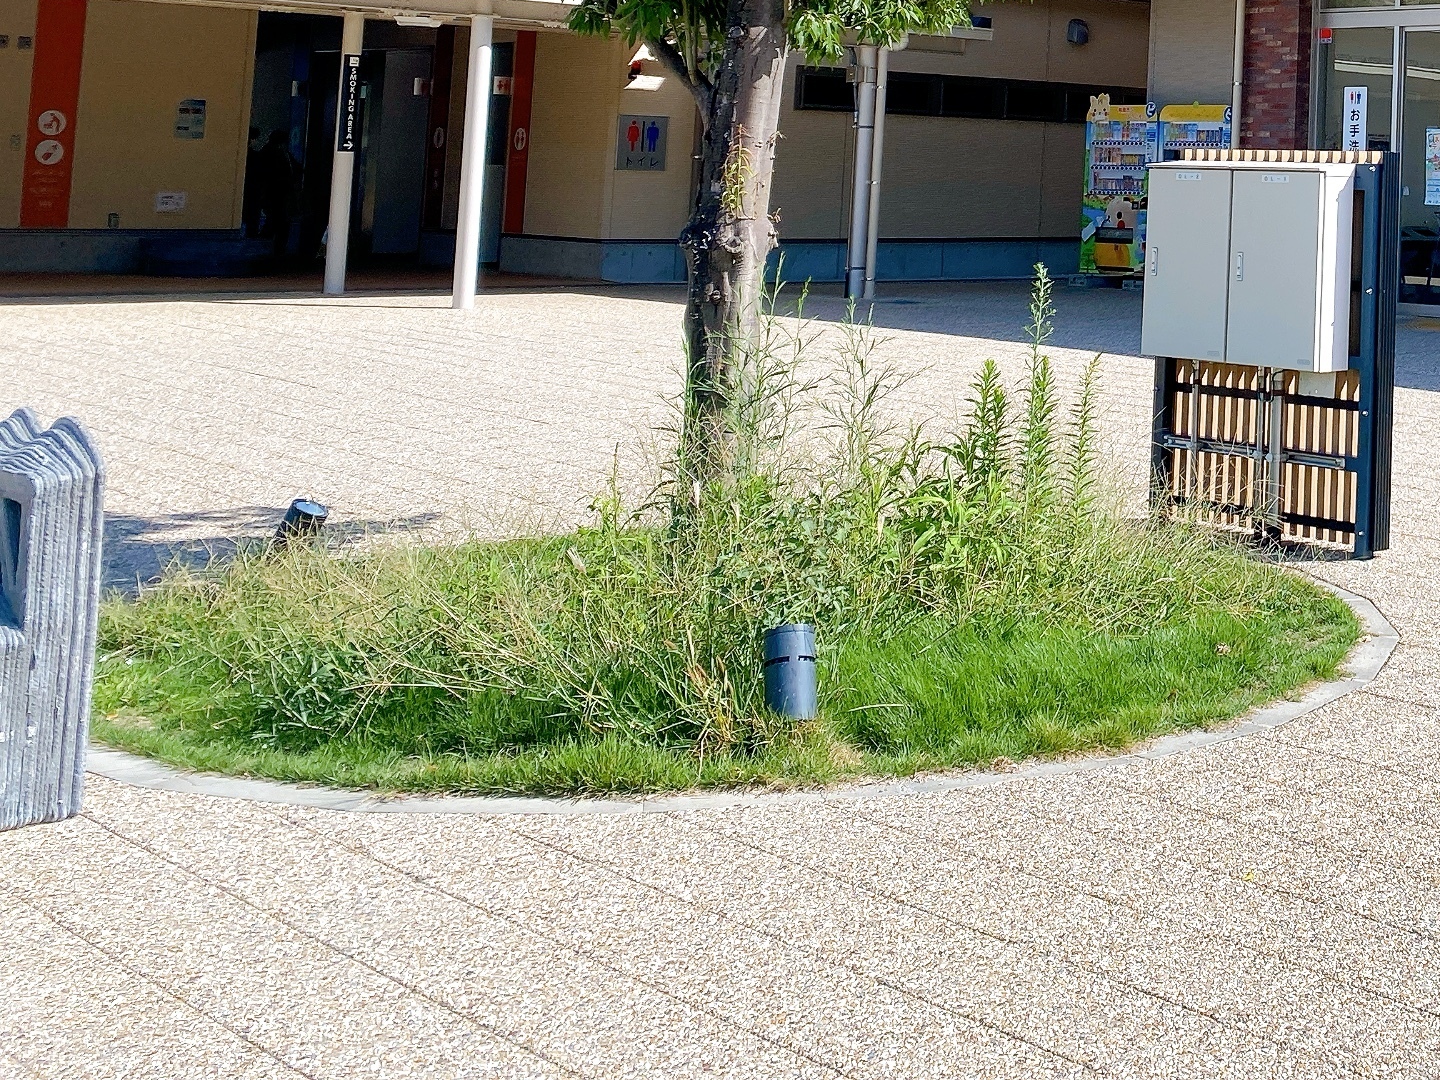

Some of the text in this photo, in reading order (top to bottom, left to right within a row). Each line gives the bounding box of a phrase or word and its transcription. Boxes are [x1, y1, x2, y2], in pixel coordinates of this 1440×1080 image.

[346, 67, 357, 139] SMOKING AREA
[626, 156, 659, 169] トイレ
